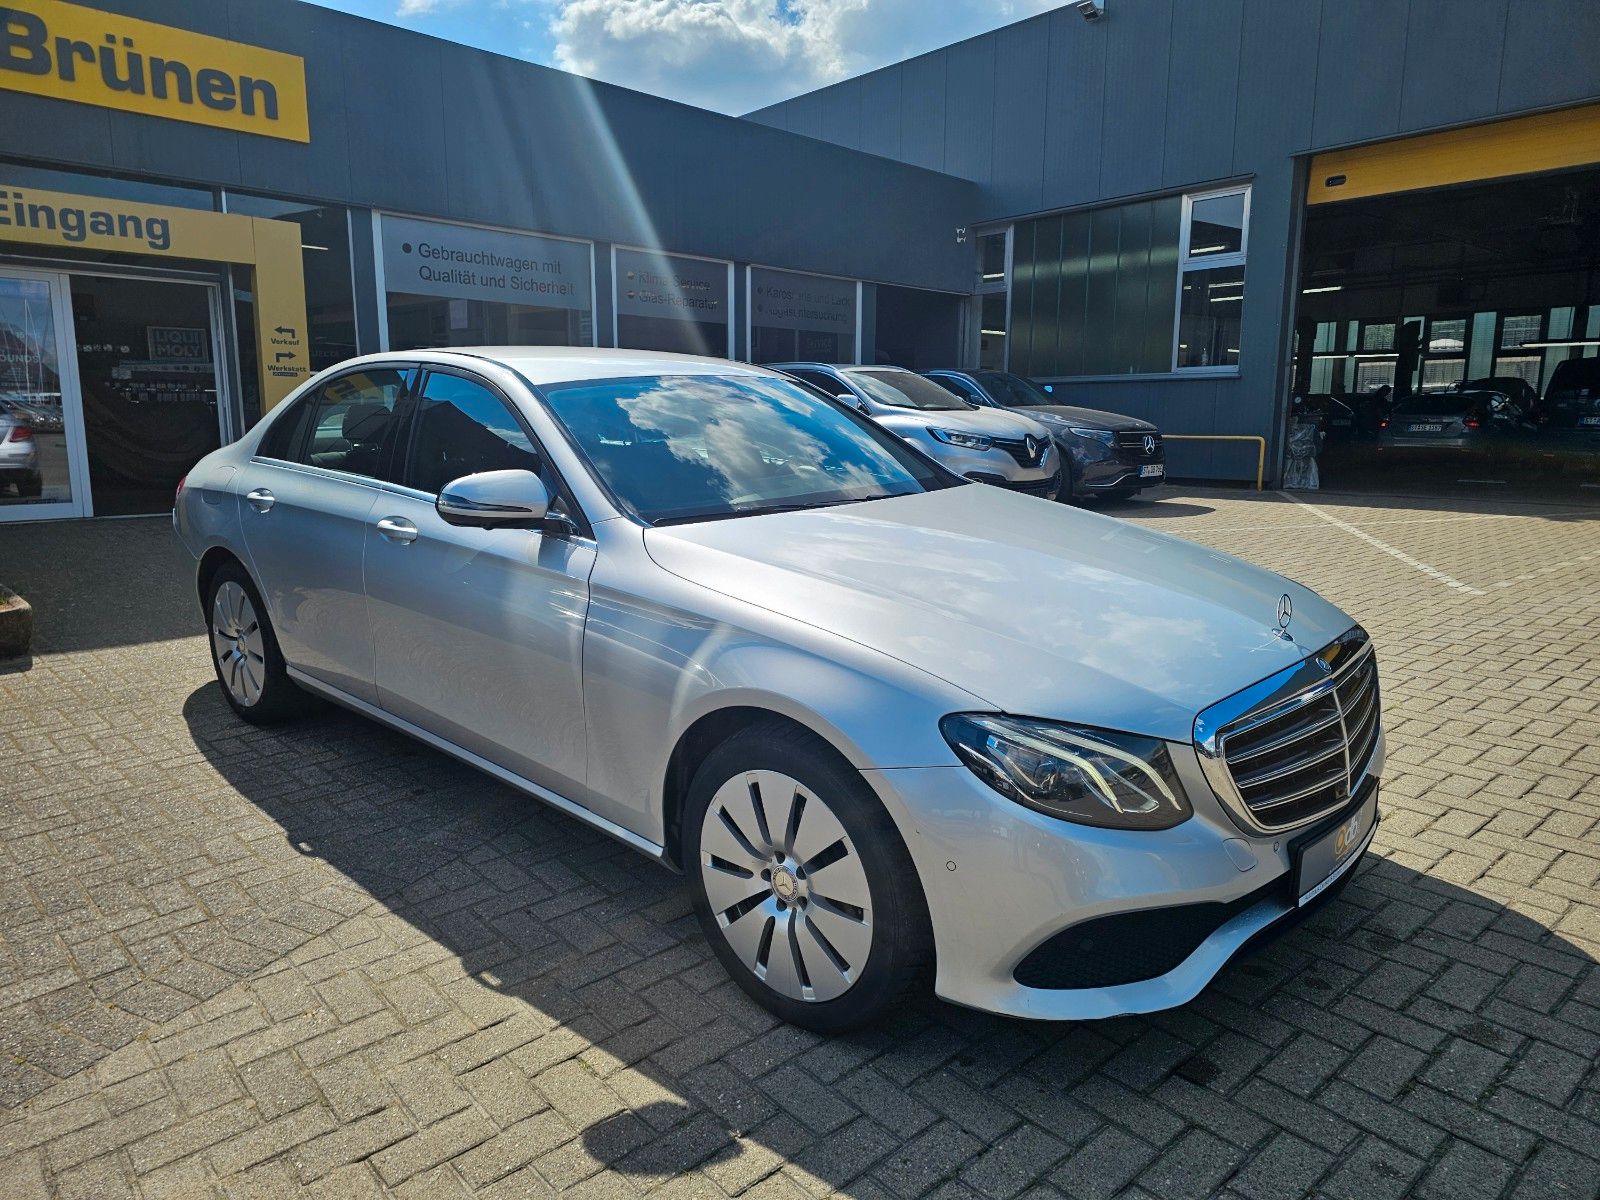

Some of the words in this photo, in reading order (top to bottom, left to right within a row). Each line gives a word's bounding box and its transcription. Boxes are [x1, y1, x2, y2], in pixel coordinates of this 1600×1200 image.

[0, 7, 278, 120] Brünen
[418, 242, 538, 273] Gebrauchtwagen
[542, 260, 562, 275] mit
[418, 265, 476, 286] Qualität
[480, 275, 506, 289] und
[510, 276, 576, 296] Sicherheit
[638, 271, 711, 291] KlimaService
[270, 337, 300, 346] Verkauf
[267, 364, 307, 373] Werkstatt
